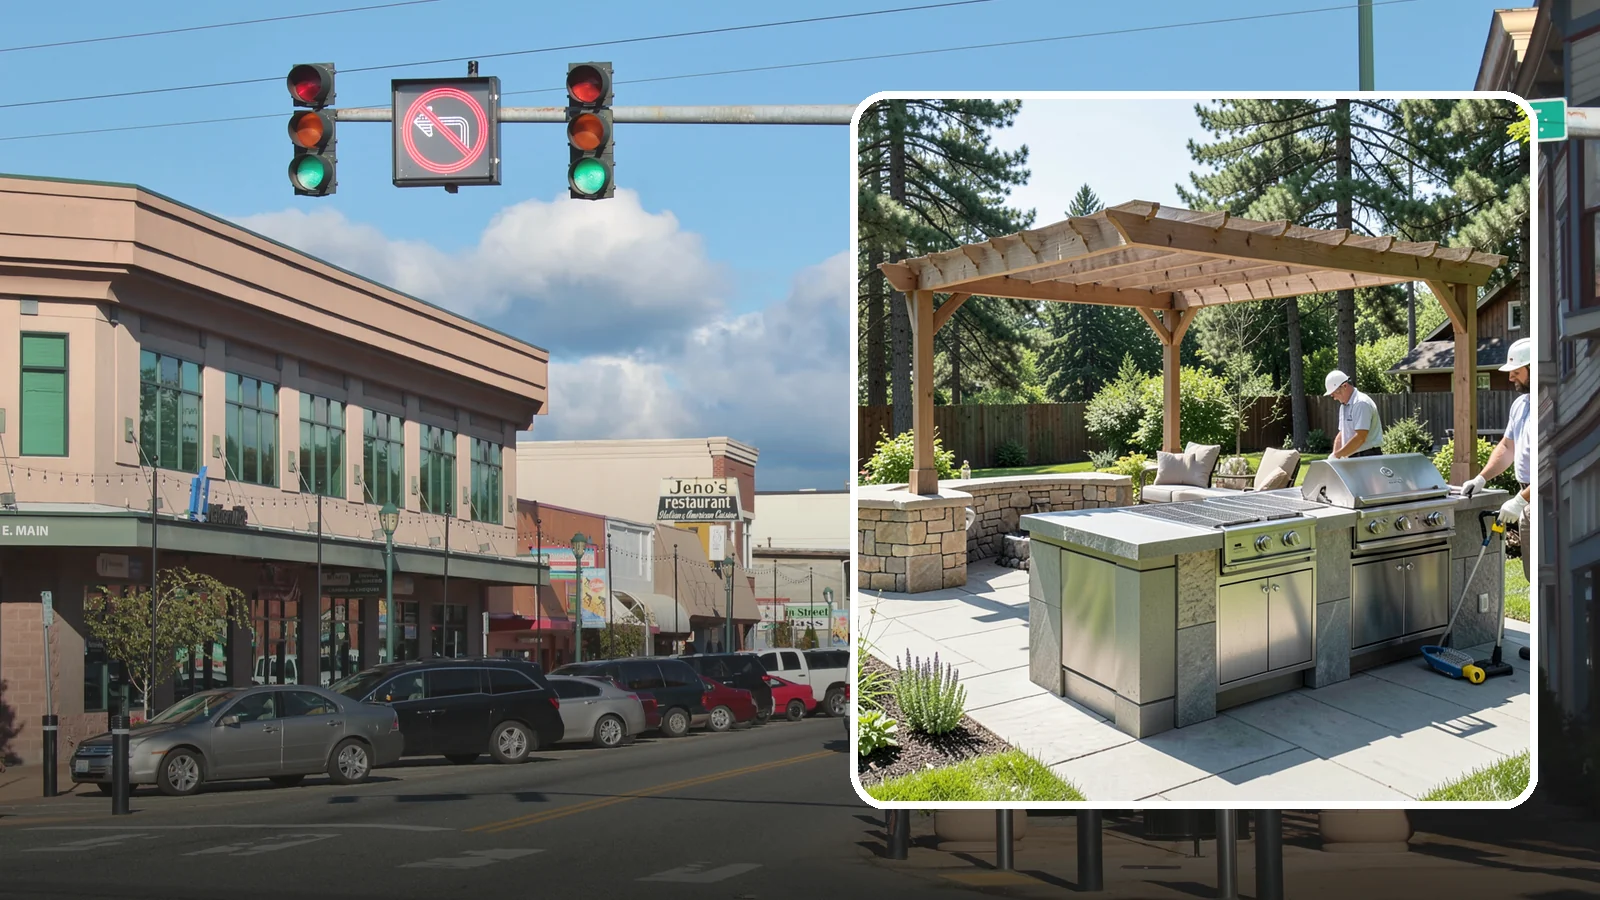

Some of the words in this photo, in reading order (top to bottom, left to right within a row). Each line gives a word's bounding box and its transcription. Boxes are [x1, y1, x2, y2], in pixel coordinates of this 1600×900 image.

[670, 480, 727, 495] Jeno's
[665, 496, 731, 509] restaurant
[686, 510, 714, 519] American
[715, 509, 737, 519] Cuisine
[2, 525, 13, 536] E.
[15, 525, 49, 536] MAIN
[797, 607, 828, 617] Street
